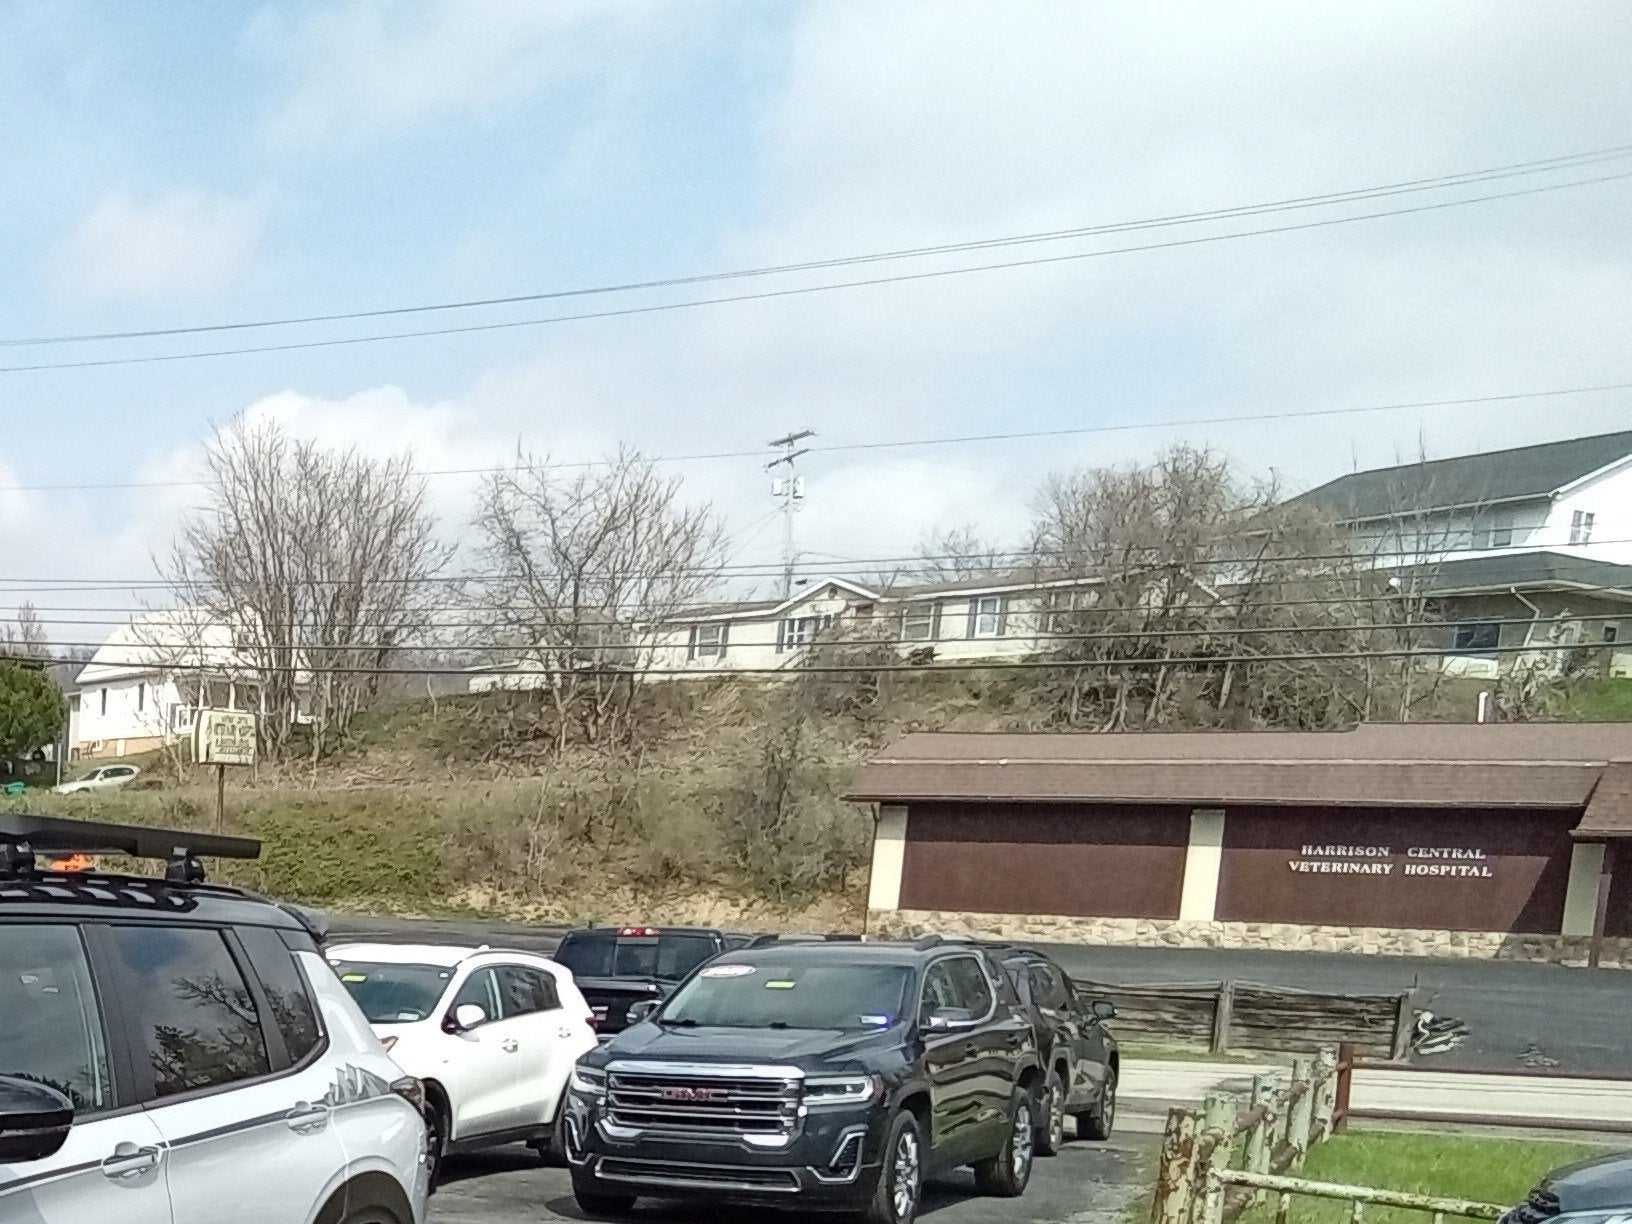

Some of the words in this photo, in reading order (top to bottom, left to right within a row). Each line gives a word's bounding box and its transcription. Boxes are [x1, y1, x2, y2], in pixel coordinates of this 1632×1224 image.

[1301, 844, 1391, 857] HARRISON
[1407, 847, 1486, 859] CENTRAL
[1288, 860, 1394, 875] VETERINARY
[1404, 864, 1493, 877] HOSPITAL
